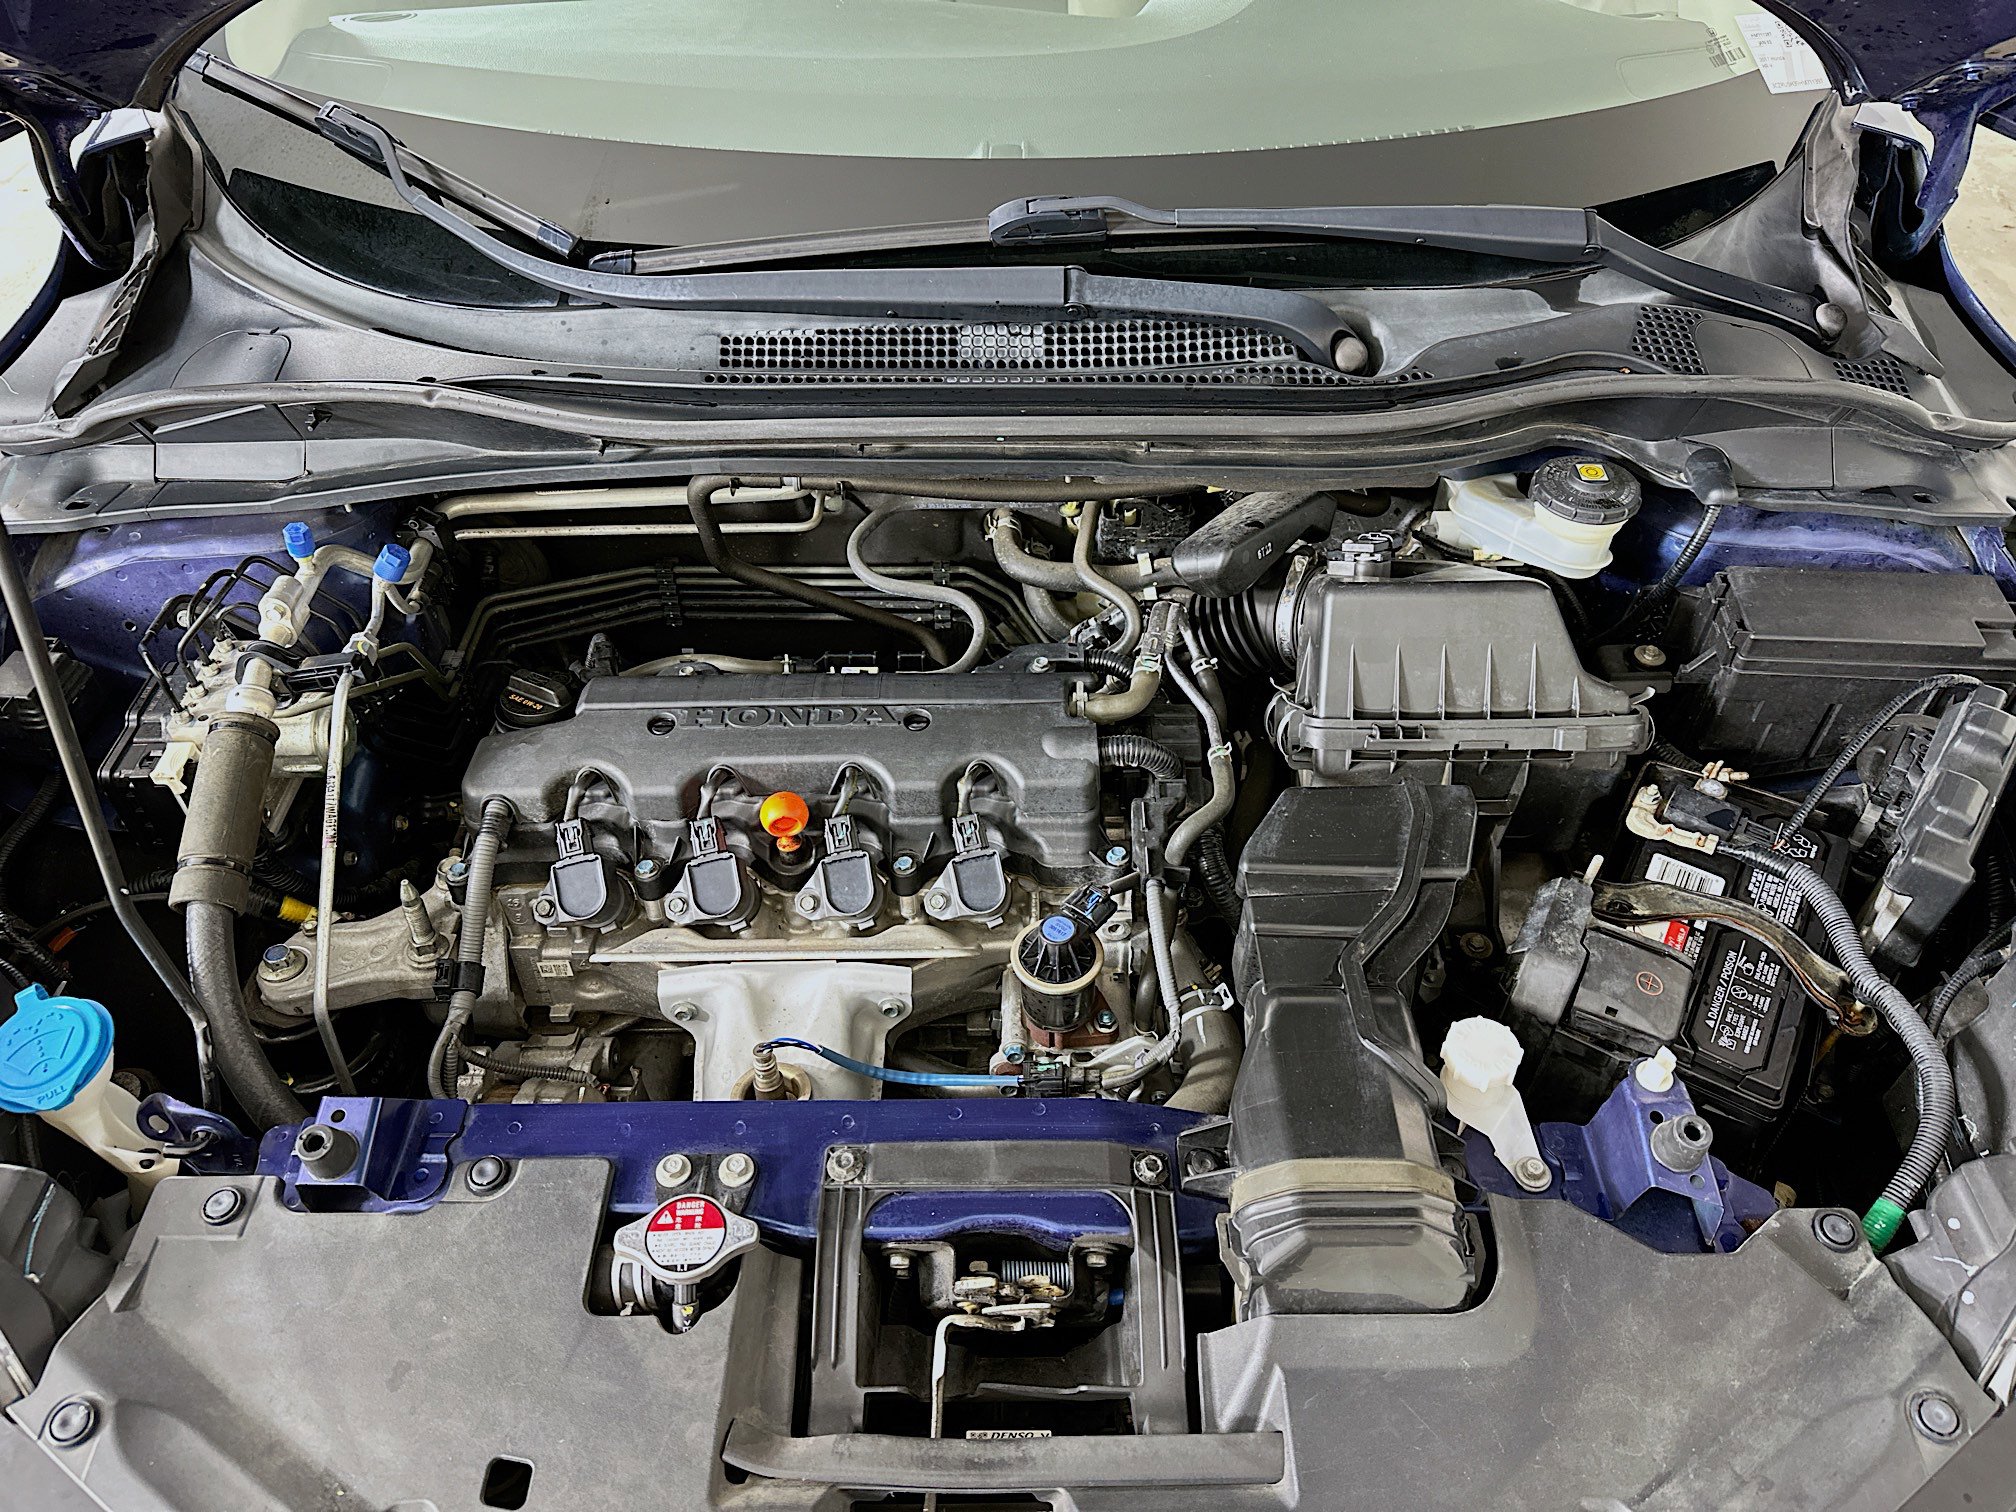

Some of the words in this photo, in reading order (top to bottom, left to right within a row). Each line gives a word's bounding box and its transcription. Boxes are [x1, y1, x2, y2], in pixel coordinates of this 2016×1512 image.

[678, 705, 901, 728] HONDA
[1708, 984, 1726, 1019] DANGER
[1720, 949, 1737, 980] POISON
[36, 1085, 68, 1105] PULL
[676, 1200, 704, 1208] DANGER
